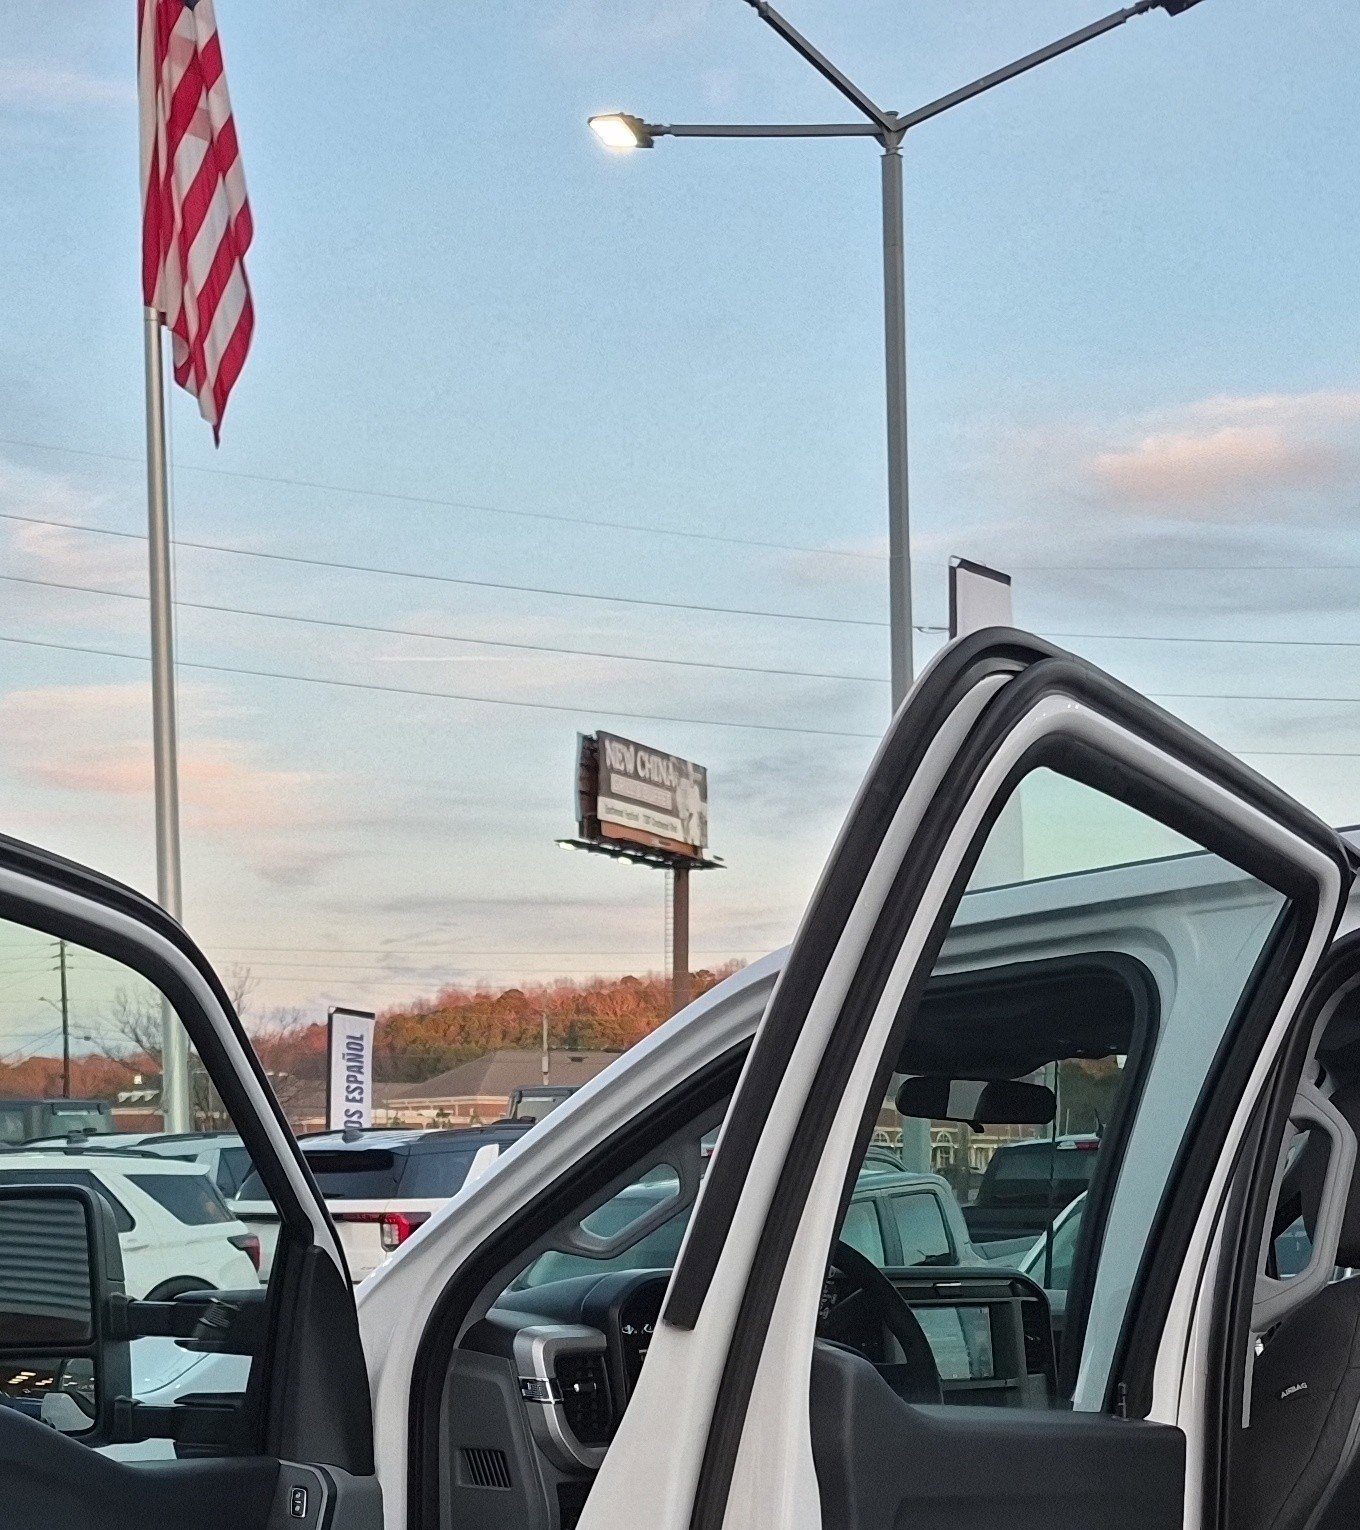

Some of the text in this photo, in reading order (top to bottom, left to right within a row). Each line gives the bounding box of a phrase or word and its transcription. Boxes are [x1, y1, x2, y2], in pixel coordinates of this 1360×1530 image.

[604, 739, 636, 774] NEW
[342, 1033, 365, 1105] ESPAÑOL
[1280, 1382, 1308, 1399] AIRBAG
